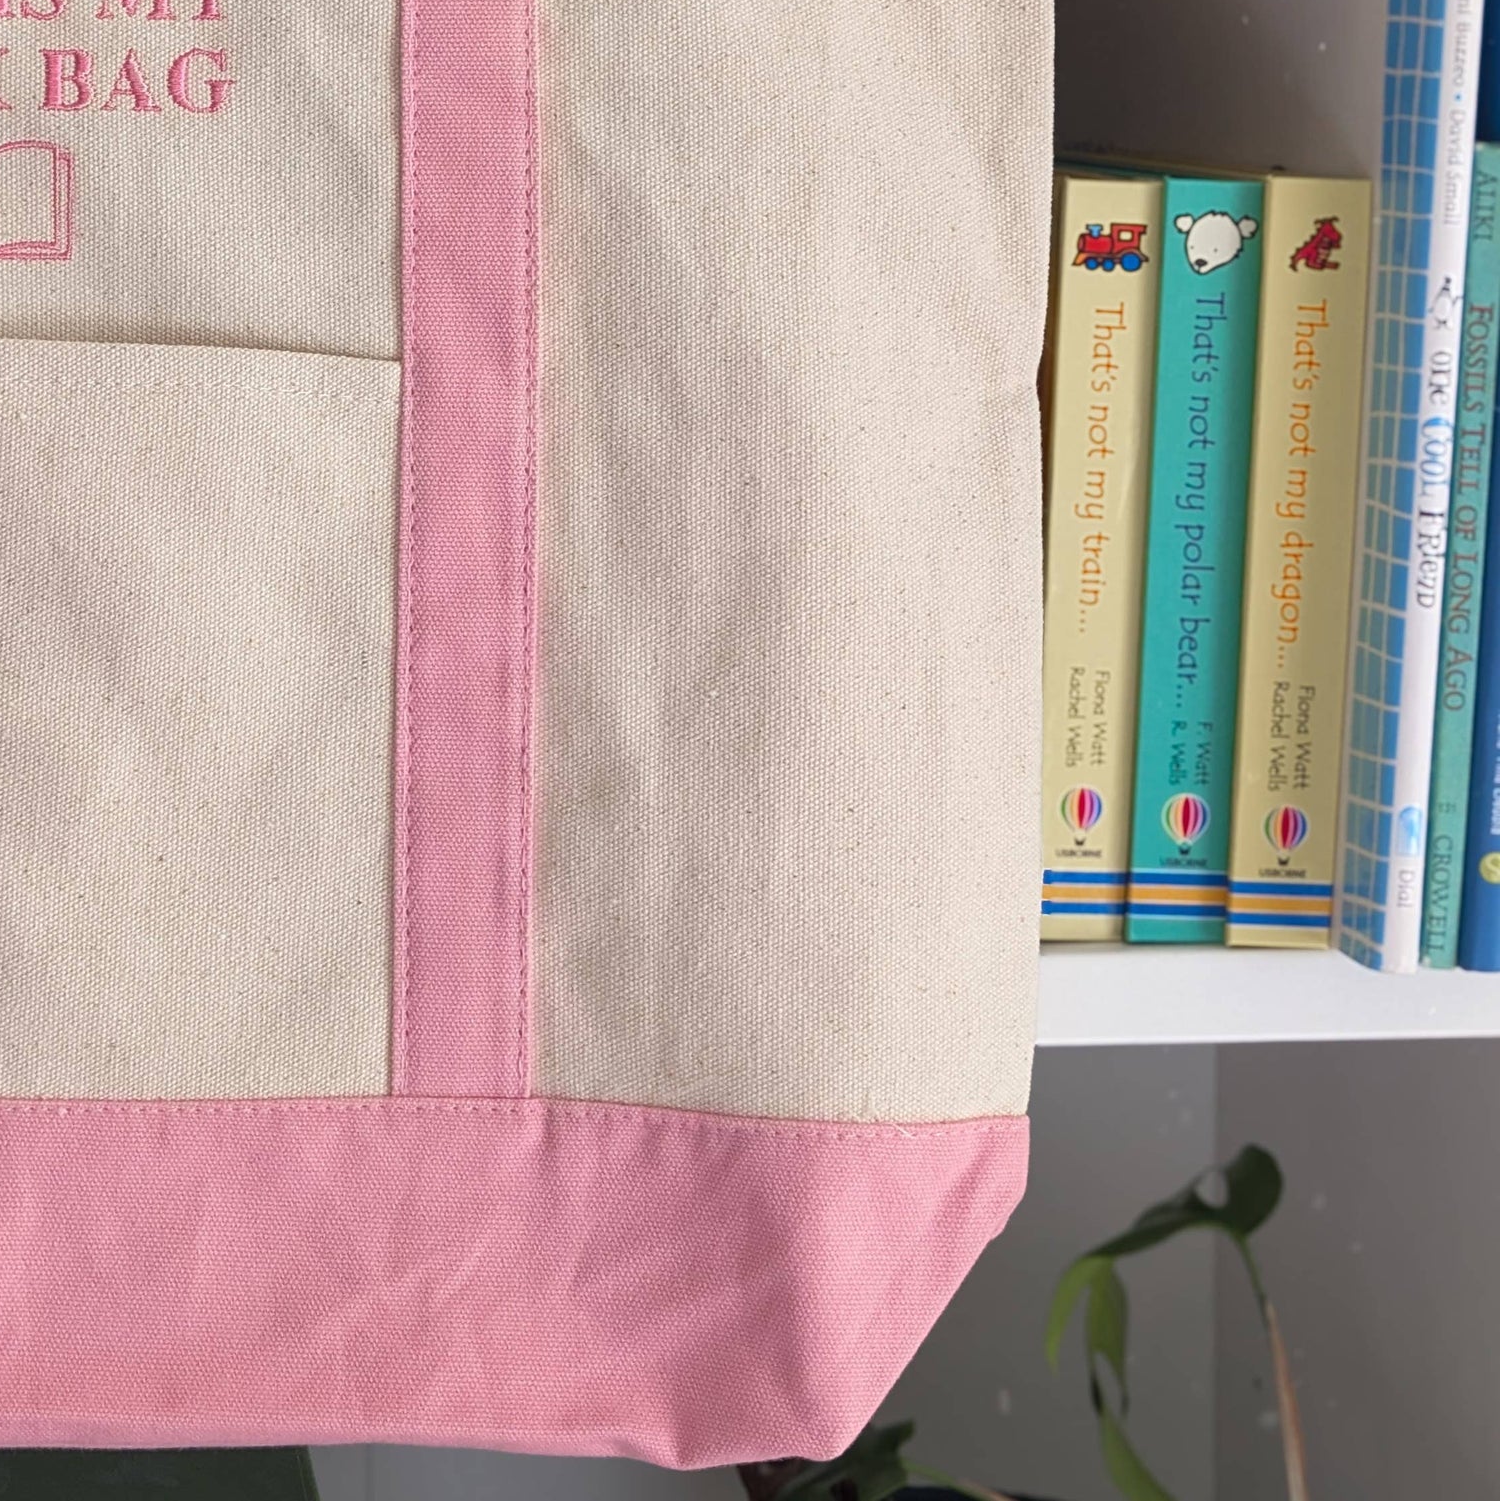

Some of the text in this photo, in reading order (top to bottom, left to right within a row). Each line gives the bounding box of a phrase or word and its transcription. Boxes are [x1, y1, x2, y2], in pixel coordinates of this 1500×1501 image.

[39, 46, 236, 114] BAG
[1074, 302, 1126, 519] That's not my
[1174, 292, 1227, 605] That's not my polar
[1275, 299, 1329, 519] That's not my
[1442, 553, 1477, 712] LONG AGO
[1067, 667, 1085, 719] Rachel
[1267, 681, 1289, 791] Rachel Wells
[1294, 686, 1315, 791] Fiona Watt
[1167, 744, 1185, 786] Wells
